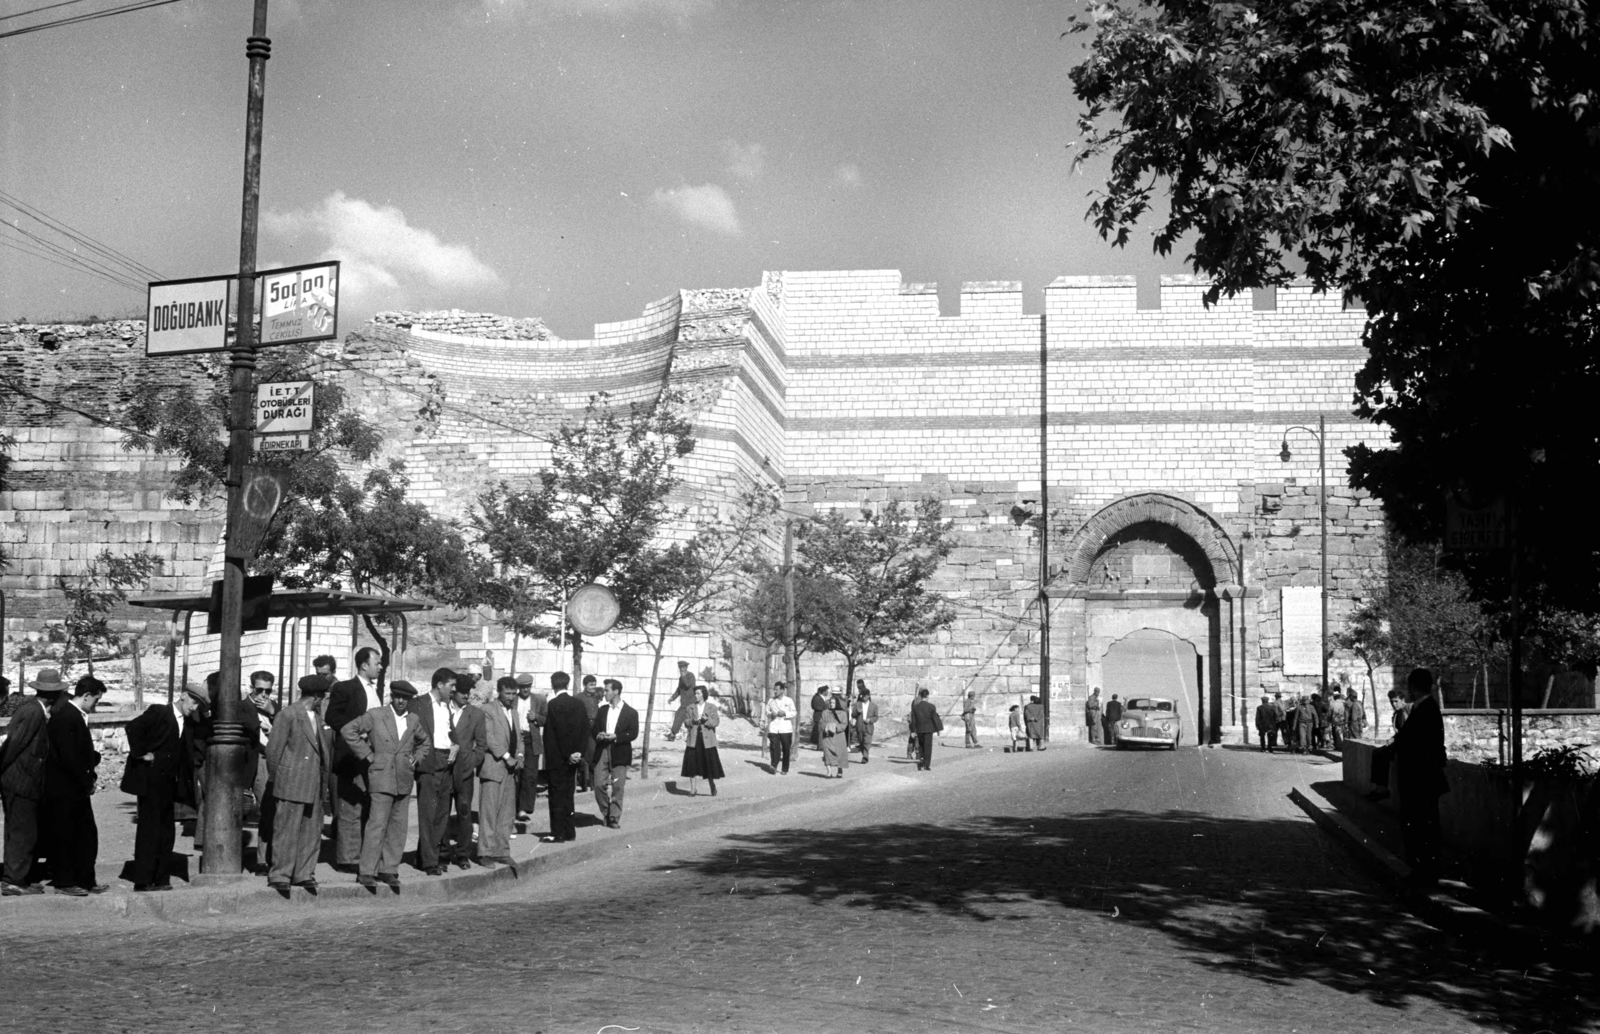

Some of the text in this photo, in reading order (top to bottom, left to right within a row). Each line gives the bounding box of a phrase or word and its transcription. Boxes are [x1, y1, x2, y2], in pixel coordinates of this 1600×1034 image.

[270, 318, 303, 330] TEMMUZ
[260, 395, 311, 408] OTOBÜSLERİ
[263, 407, 306, 420] DURAĞI
